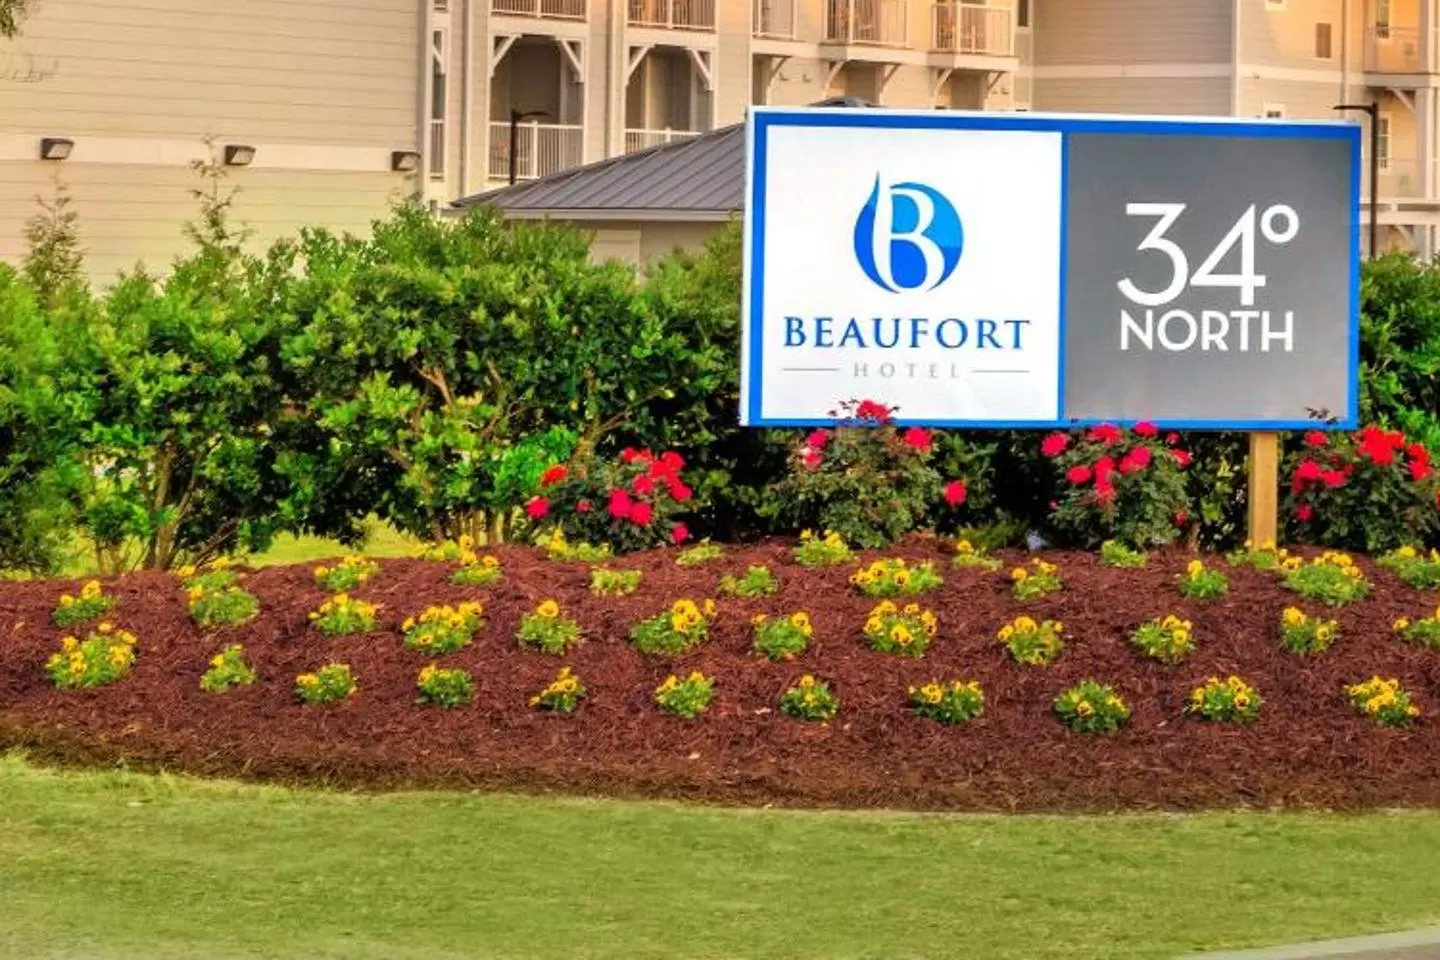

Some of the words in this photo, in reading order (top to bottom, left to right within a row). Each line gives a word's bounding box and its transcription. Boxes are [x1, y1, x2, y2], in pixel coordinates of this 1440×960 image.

[782, 315, 1031, 351] BEAUFORT
[1120, 308, 1294, 352] NORTH
[852, 361, 960, 379] HOTEL
